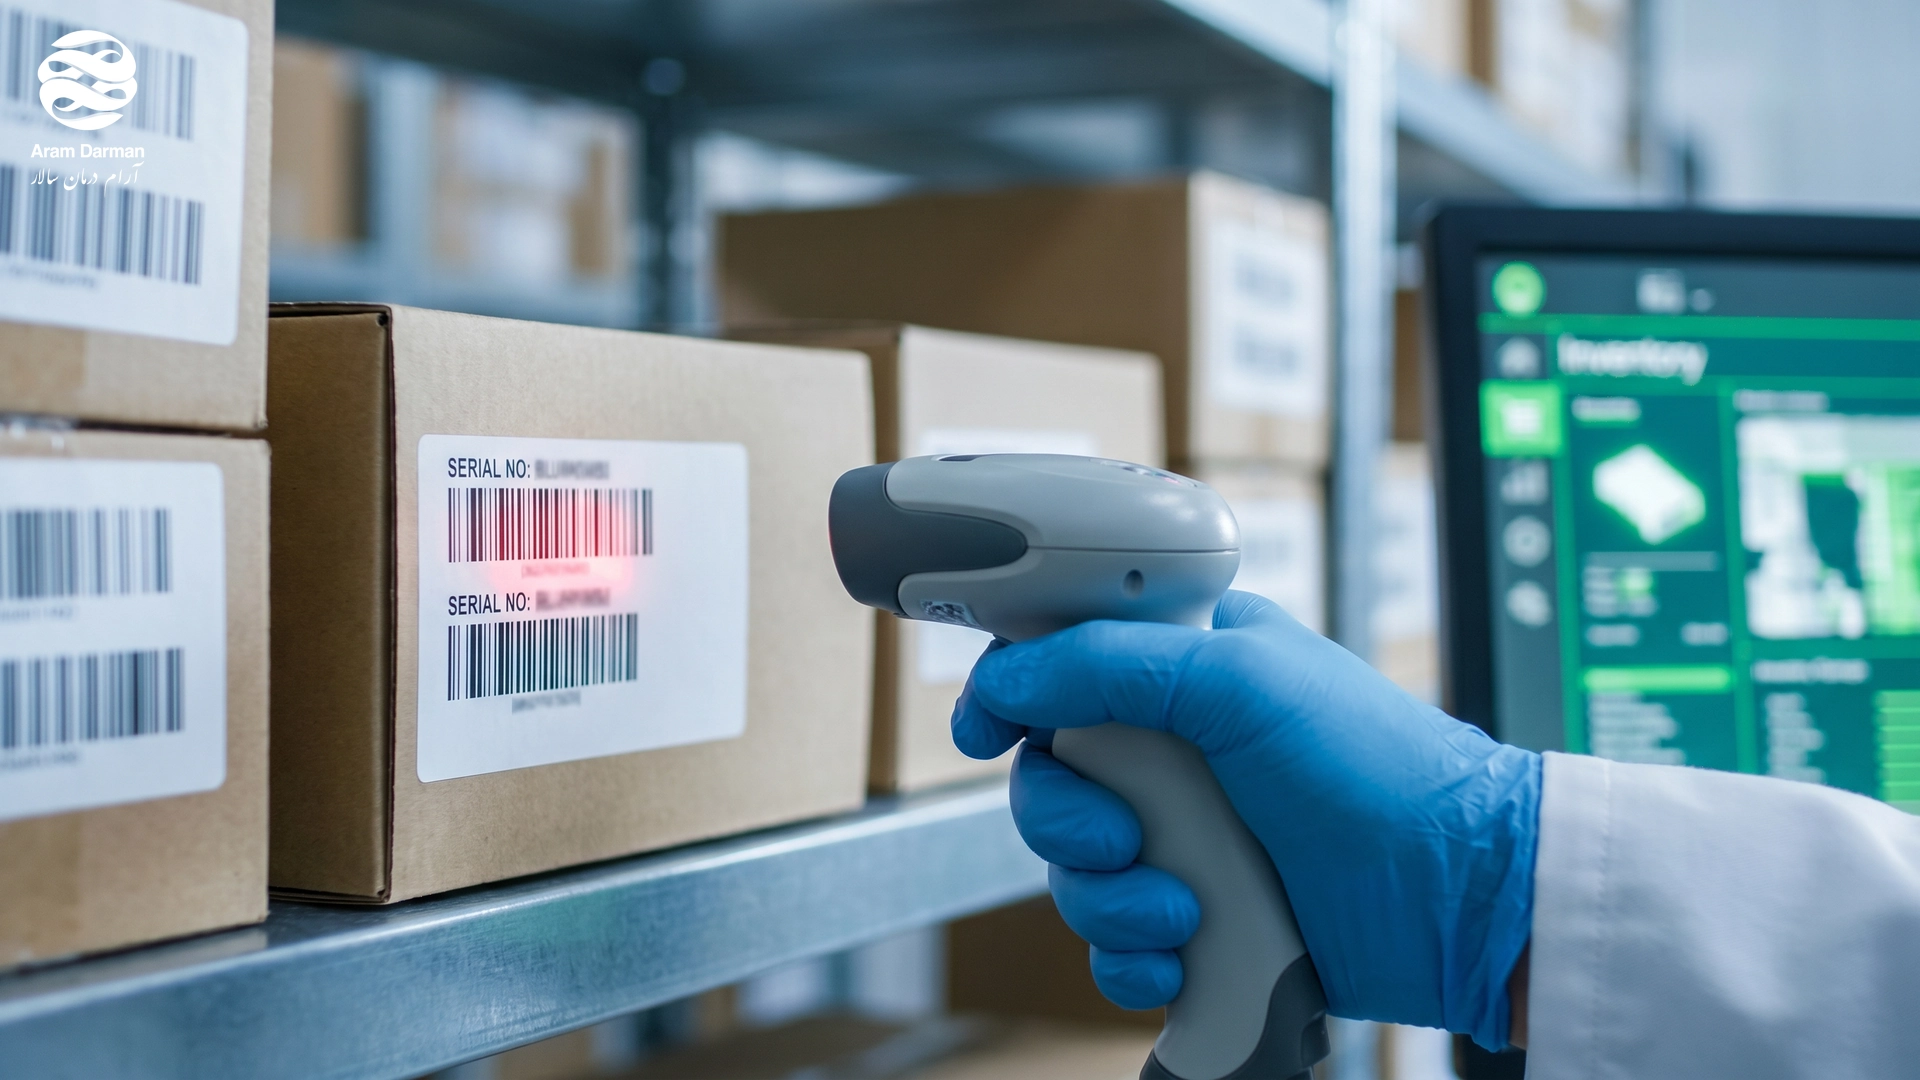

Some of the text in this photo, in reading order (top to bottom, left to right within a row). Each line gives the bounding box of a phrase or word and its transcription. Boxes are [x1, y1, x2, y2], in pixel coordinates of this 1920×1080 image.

[1557, 334, 1708, 386] Inventory
[448, 457, 501, 478] SERIAL
[506, 459, 531, 478] NO:
[448, 594, 501, 616] SERIAL
[506, 592, 531, 612] NO:
